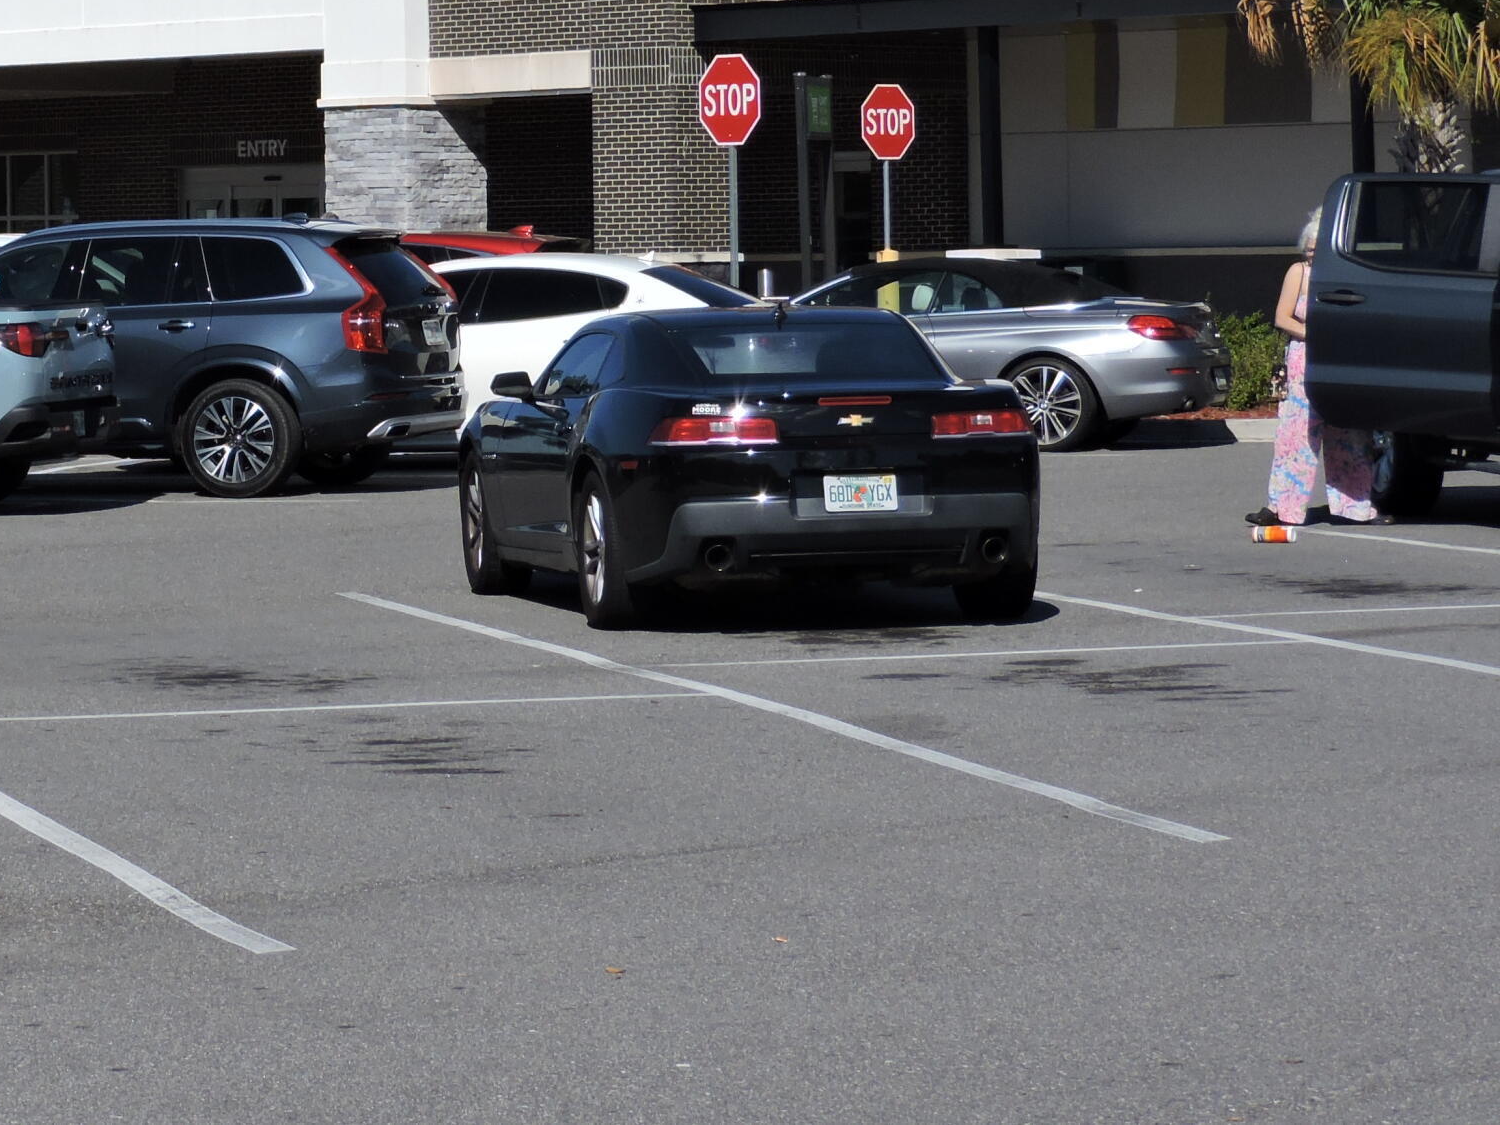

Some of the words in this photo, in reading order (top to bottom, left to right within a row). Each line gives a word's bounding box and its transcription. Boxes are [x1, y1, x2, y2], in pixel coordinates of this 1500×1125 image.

[703, 83, 756, 117] STOP
[866, 108, 911, 136] STOP
[237, 139, 288, 158] ENTRY
[868, 483, 893, 502] YGX
